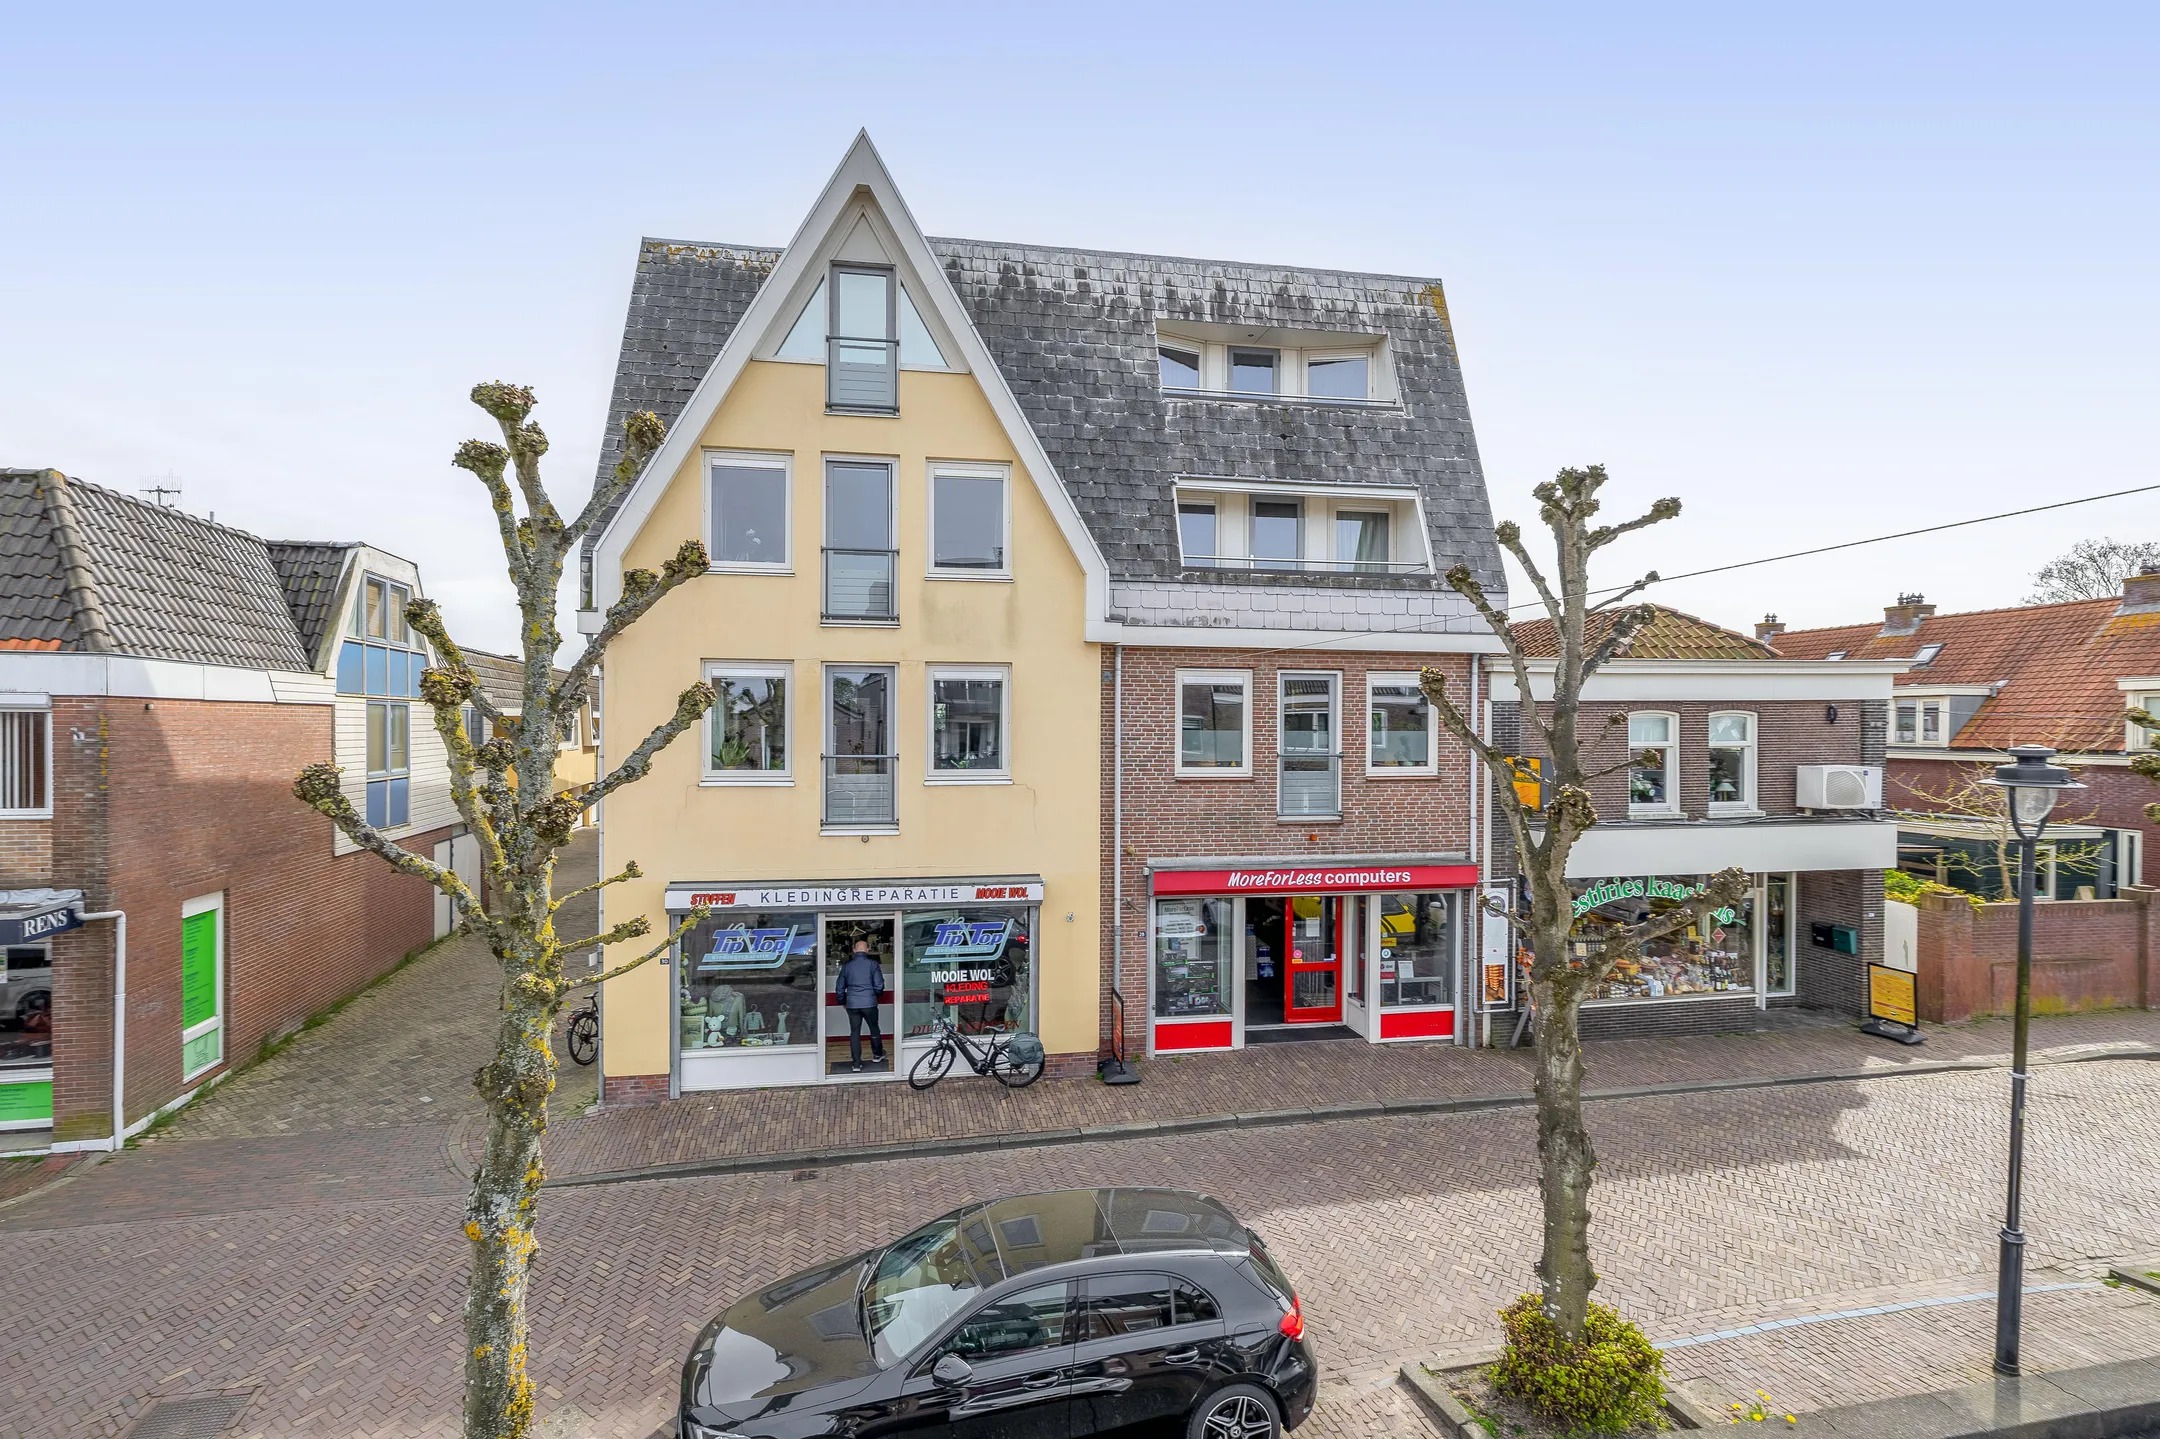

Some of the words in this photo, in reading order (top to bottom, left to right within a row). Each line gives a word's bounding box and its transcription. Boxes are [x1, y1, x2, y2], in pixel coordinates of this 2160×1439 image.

[1228, 871, 1322, 887] MoreForLess
[1325, 870, 1411, 886] computers
[690, 893, 737, 906] STOFFEN
[760, 888, 959, 903] KLEDINGREPARATIE
[975, 887, 1007, 899] MOOIE
[1008, 886, 1029, 898] WOL
[1571, 877, 1644, 918] estfries
[22, 909, 68, 938] RENS
[712, 928, 748, 954] Tip
[751, 927, 789, 955] Top
[934, 923, 968, 947] Tip
[970, 921, 1006, 946] Top
[931, 970, 968, 983] MOOIE
[969, 968, 995, 981] WOL
[945, 981, 989, 993] KLEDING
[944, 993, 990, 1004] REPARATIE
